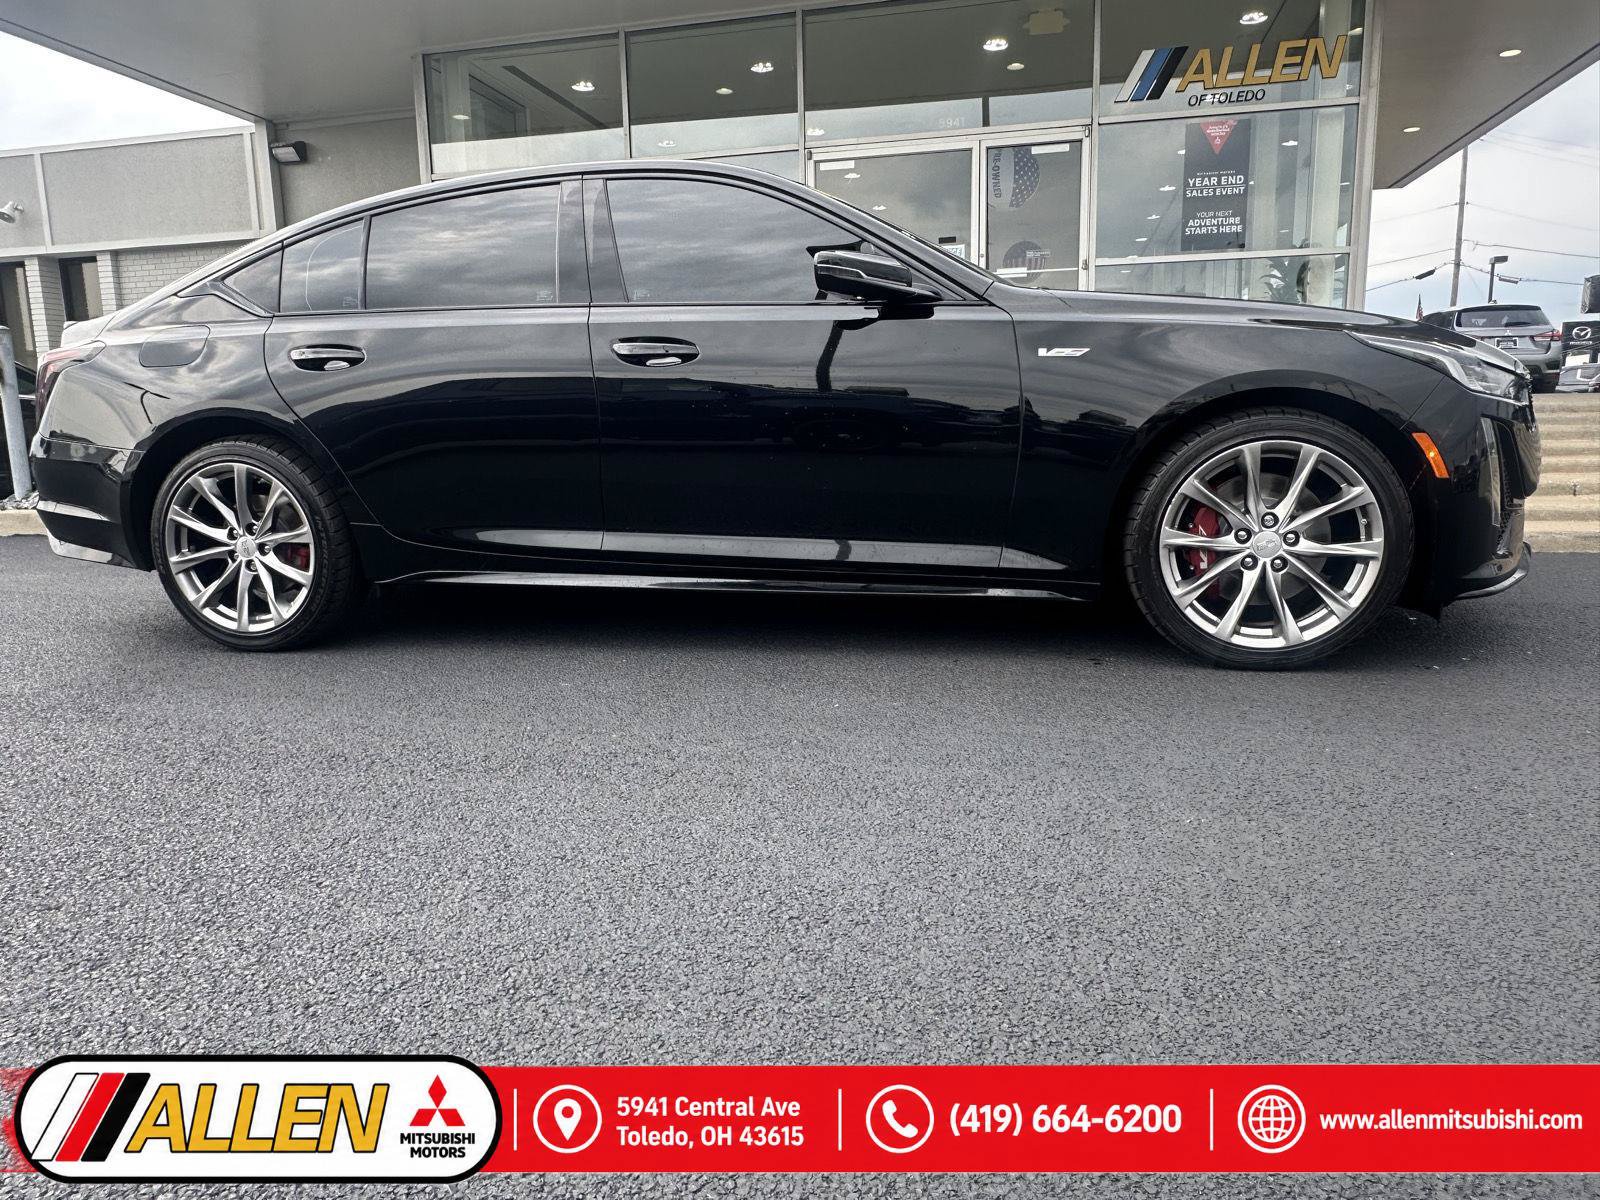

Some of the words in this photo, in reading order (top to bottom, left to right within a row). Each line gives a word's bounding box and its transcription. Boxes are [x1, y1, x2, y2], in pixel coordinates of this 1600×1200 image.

[1175, 35, 1348, 93] ALLEN
[1187, 94, 1208, 107] OF
[1210, 88, 1266, 104] TOLEDO
[1188, 176, 1218, 187] YEAR
[1221, 174, 1245, 185] END
[1186, 188, 1214, 198] SALES
[1215, 186, 1245, 196] EVENT
[1215, 209, 1233, 217] NEXT
[1187, 216, 1241, 227] ADVENTURE
[1185, 226, 1218, 235] STARTS
[1219, 224, 1243, 233] HERE
